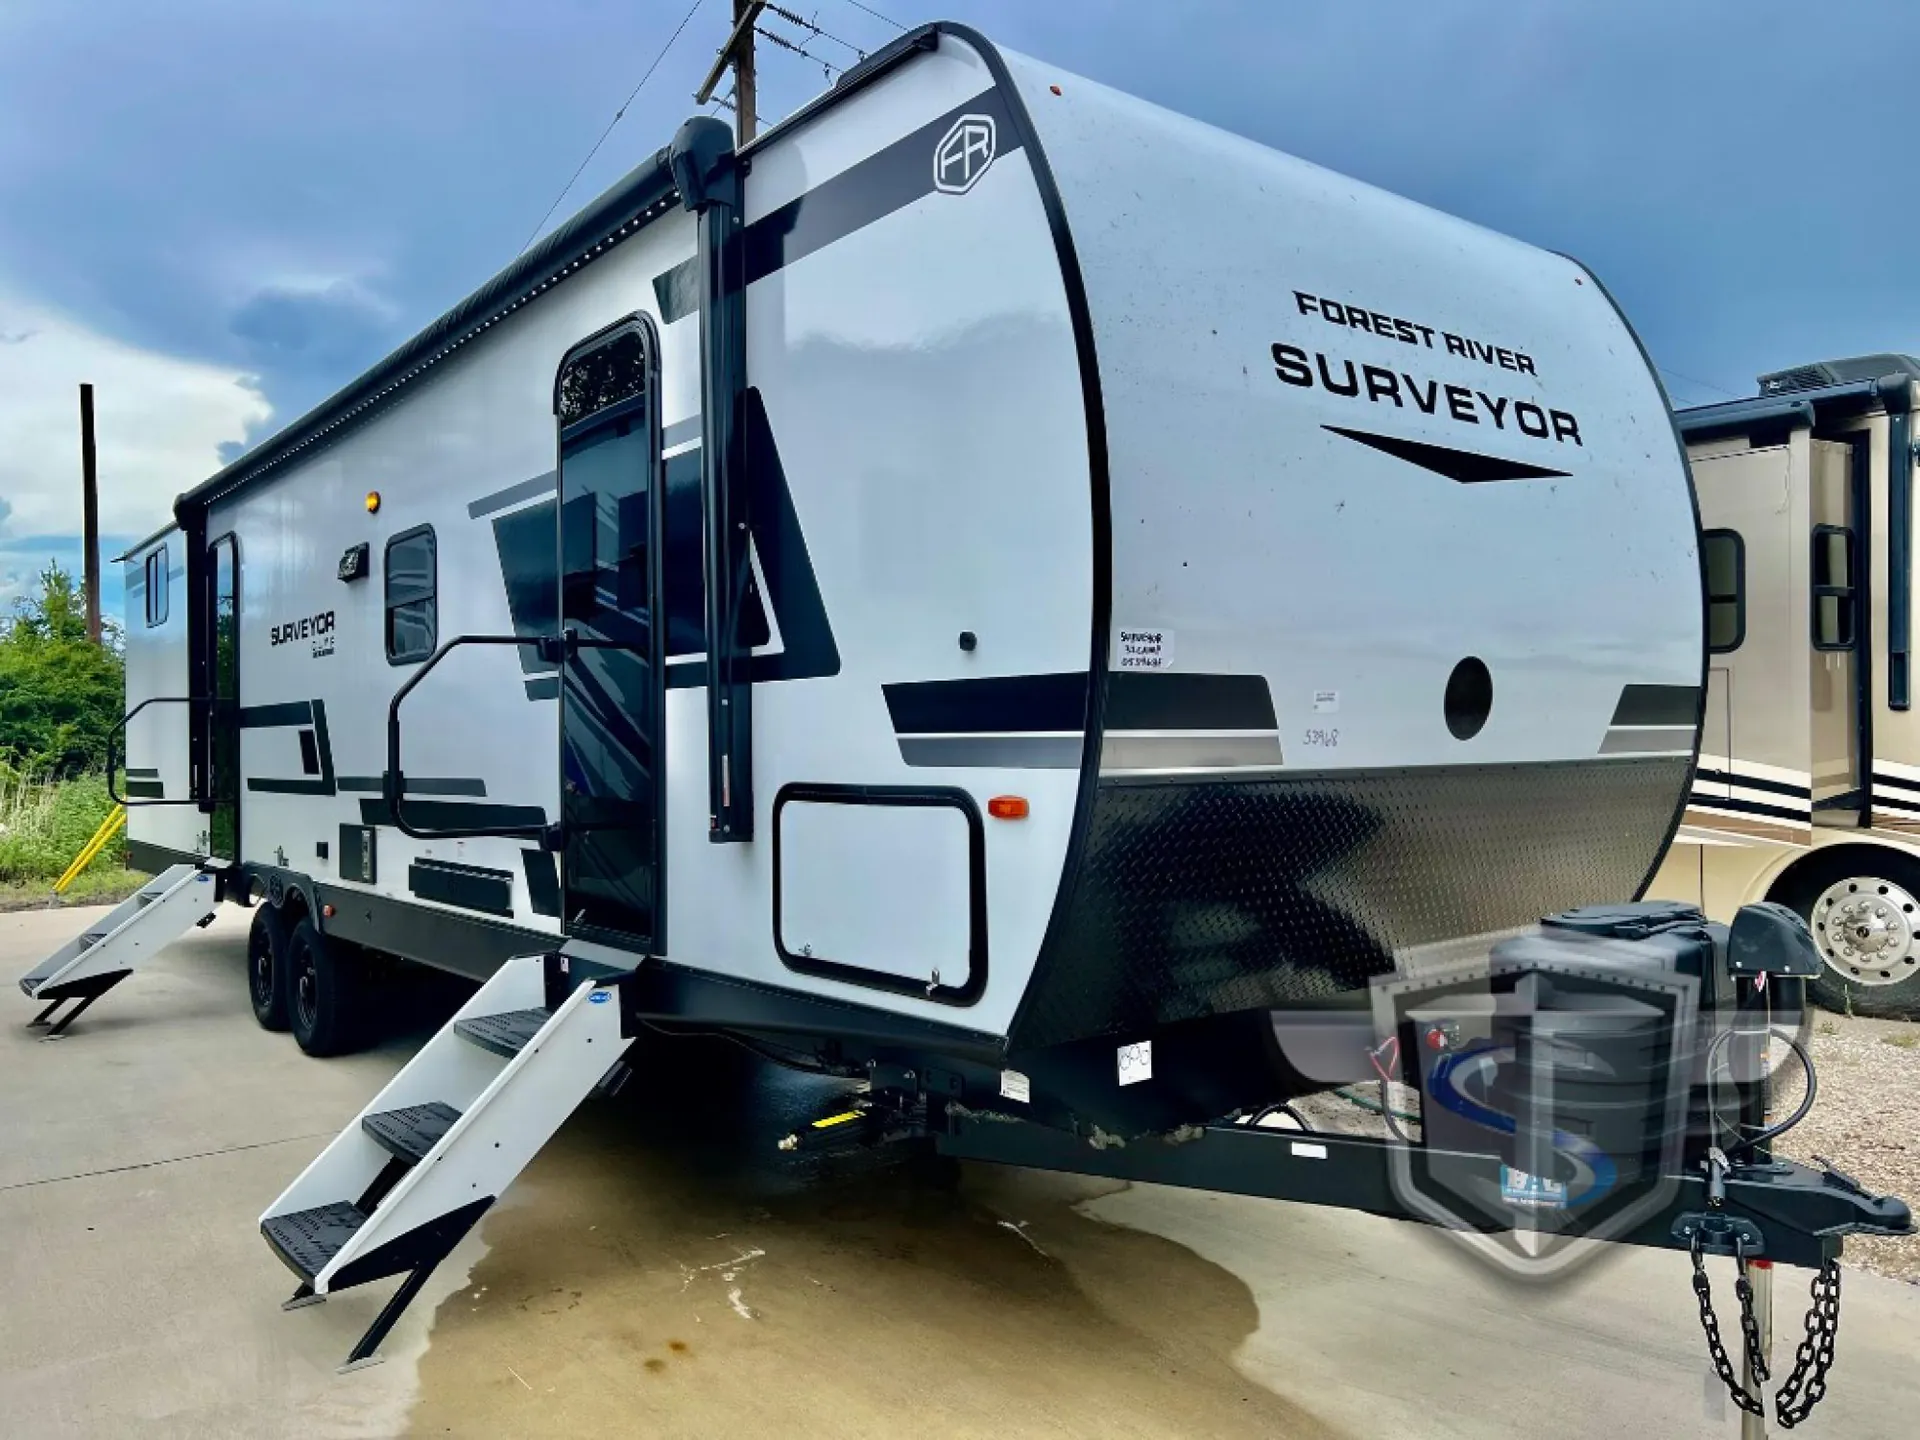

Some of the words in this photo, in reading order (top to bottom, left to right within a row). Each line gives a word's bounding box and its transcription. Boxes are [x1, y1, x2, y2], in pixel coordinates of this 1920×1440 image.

[1291, 290, 1435, 349] FOREST
[1441, 331, 1539, 377] RIVER
[1271, 342, 1584, 447] SURVEYOR
[271, 610, 335, 647] SURVEYOR
[1302, 728, 1340, 748] 53968
